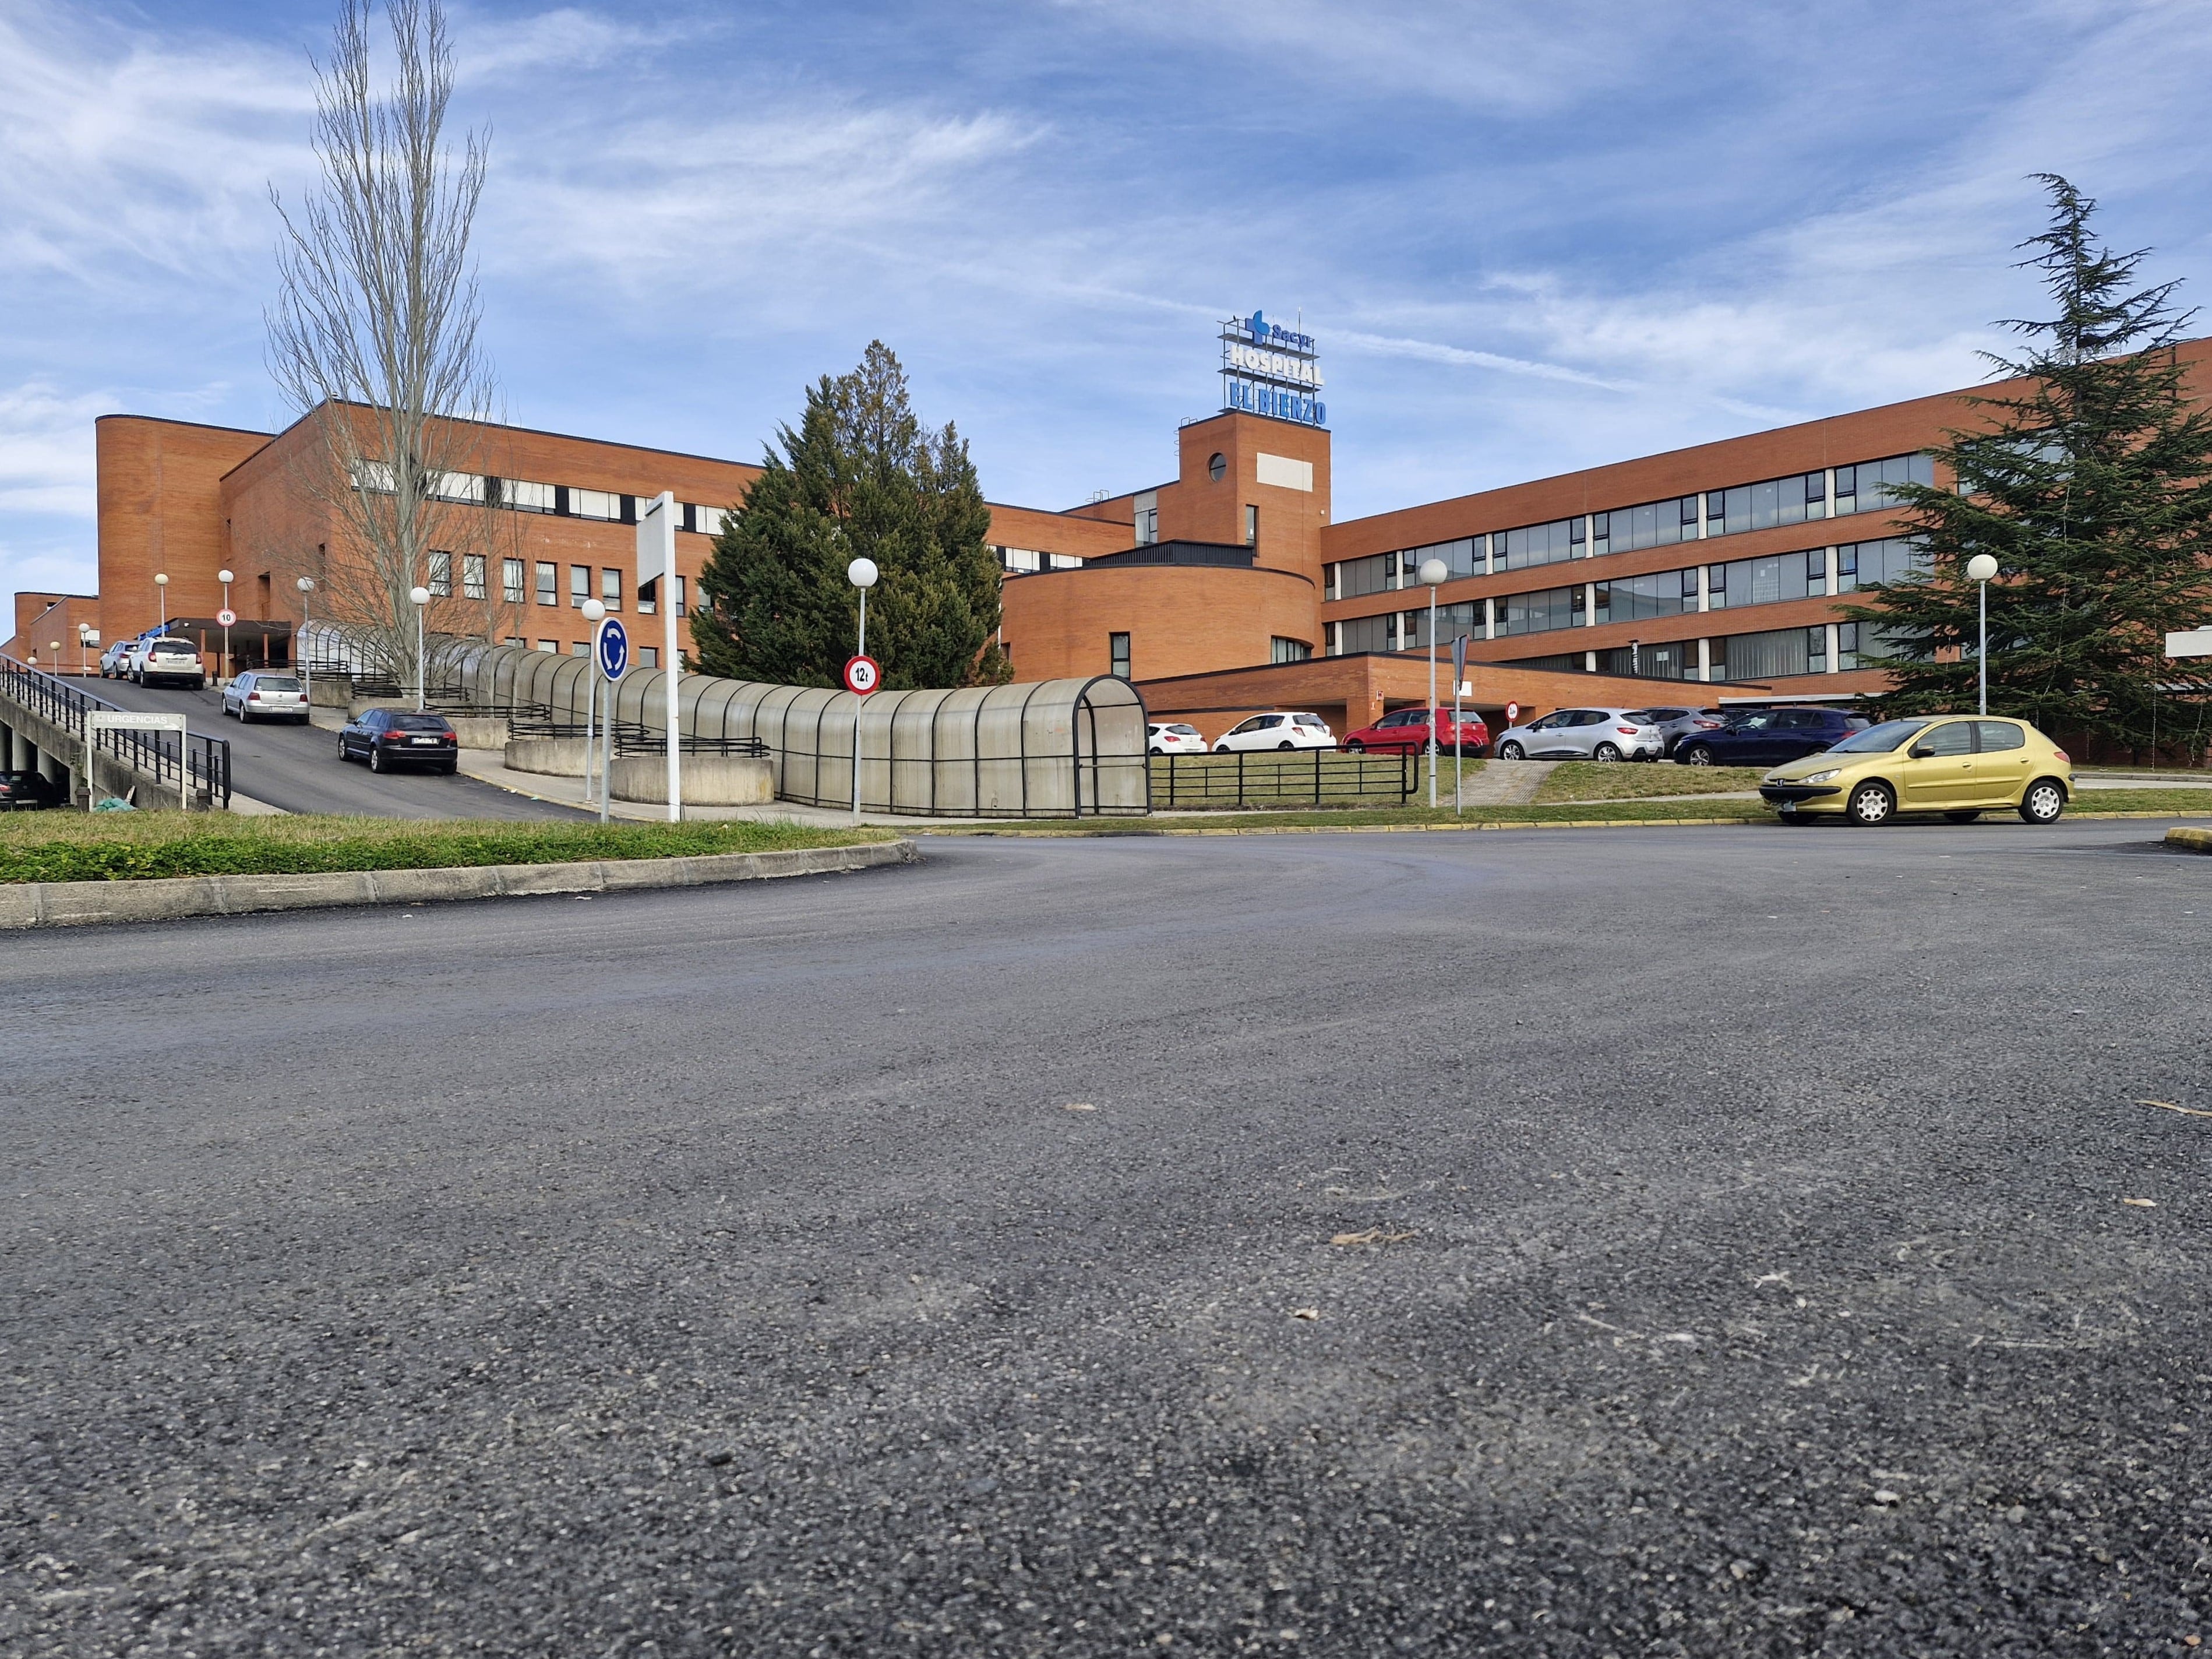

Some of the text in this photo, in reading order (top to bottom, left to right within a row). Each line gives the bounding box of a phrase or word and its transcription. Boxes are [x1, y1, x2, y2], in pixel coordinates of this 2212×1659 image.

[1230, 346, 1324, 386] HOSPITAL
[1230, 382, 1326, 425] EL BIERZO
[107, 715, 167, 724] URGENCIAS
